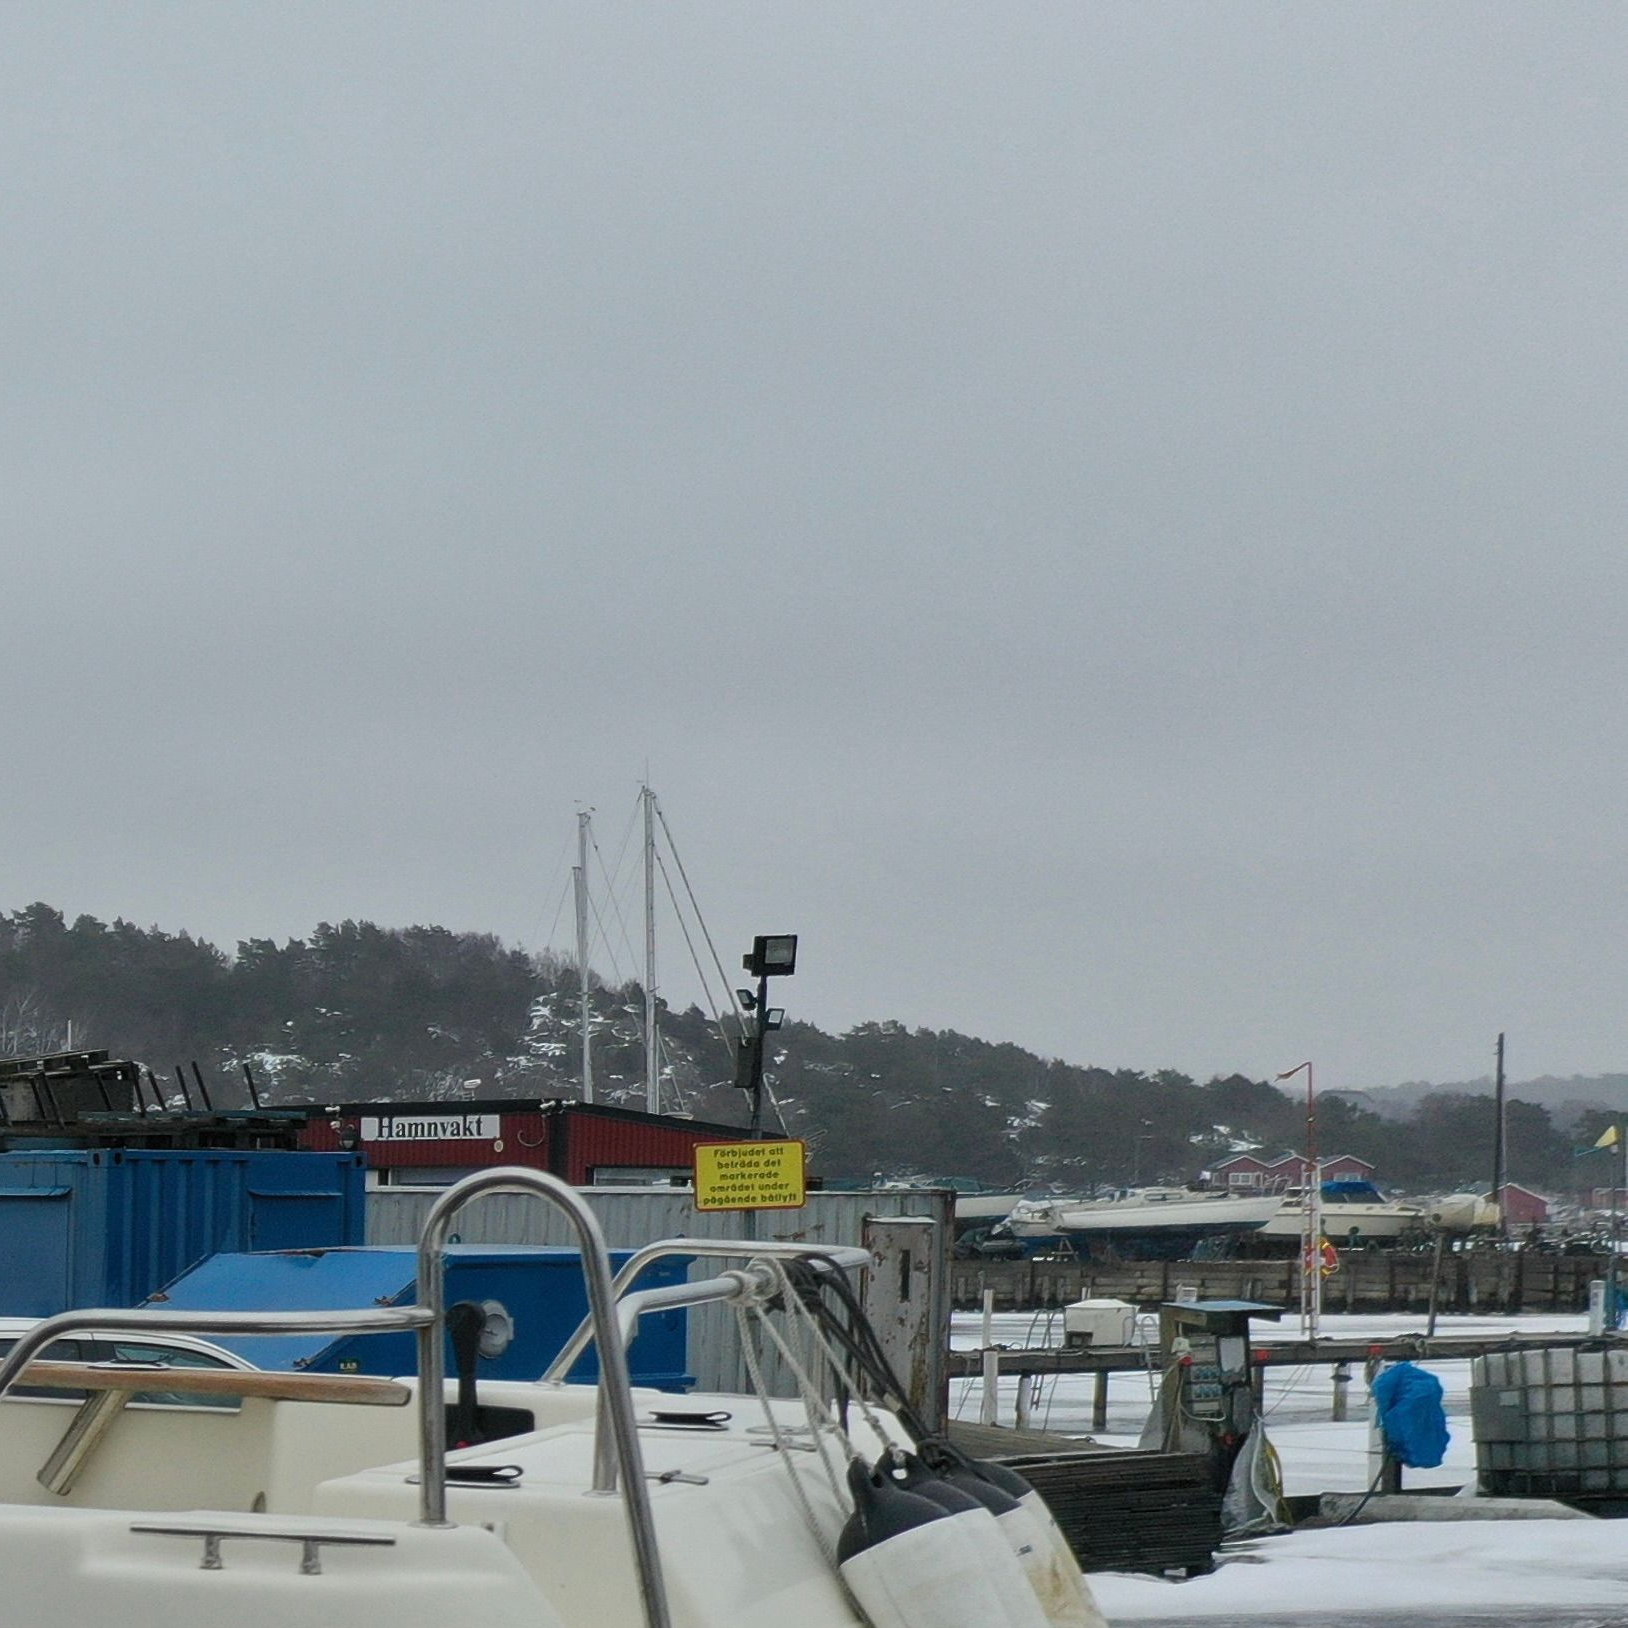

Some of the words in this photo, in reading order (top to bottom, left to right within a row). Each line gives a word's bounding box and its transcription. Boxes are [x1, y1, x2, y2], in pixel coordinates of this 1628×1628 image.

[378, 1114, 483, 1139] Hamnvakt
[713, 1147, 766, 1158] Förbjudet
[769, 1147, 784, 1156] att
[717, 1160, 760, 1170] beträda
[764, 1159, 781, 1168] det
[719, 1170, 780, 1181] markerade
[709, 1183, 755, 1193] området
[758, 1181, 790, 1191] under
[703, 1195, 757, 1206] pågående
[761, 1193, 797, 1204] båtlyft
